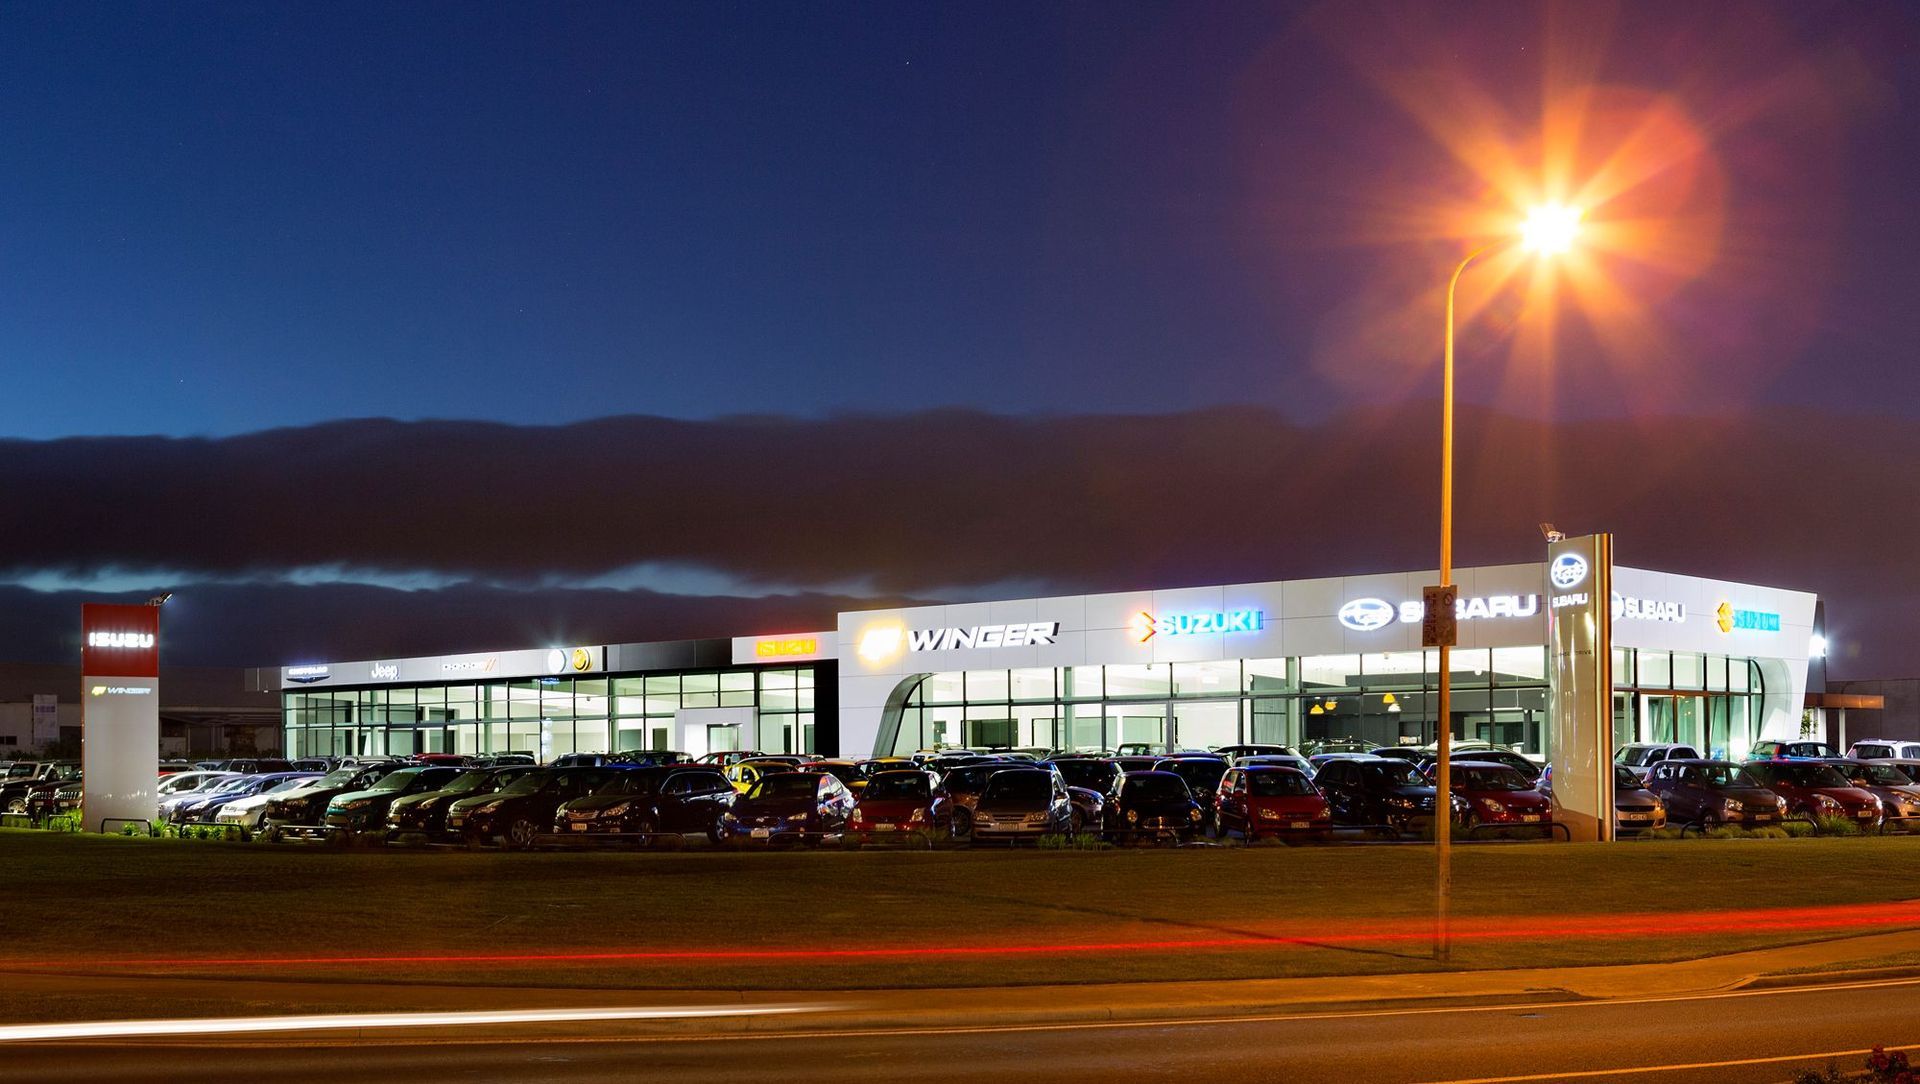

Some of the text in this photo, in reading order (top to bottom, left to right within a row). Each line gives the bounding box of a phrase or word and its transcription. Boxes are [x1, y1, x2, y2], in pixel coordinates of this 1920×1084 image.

[1399, 594, 1542, 623] SARU
[1552, 592, 1589, 608] SUBARU
[1625, 597, 1687, 623] SUBARU
[1156, 609, 1264, 636] SUZUKI
[88, 632, 155, 649] ISUZU
[907, 621, 1061, 652] WINGER
[371, 662, 399, 680] Jeep
